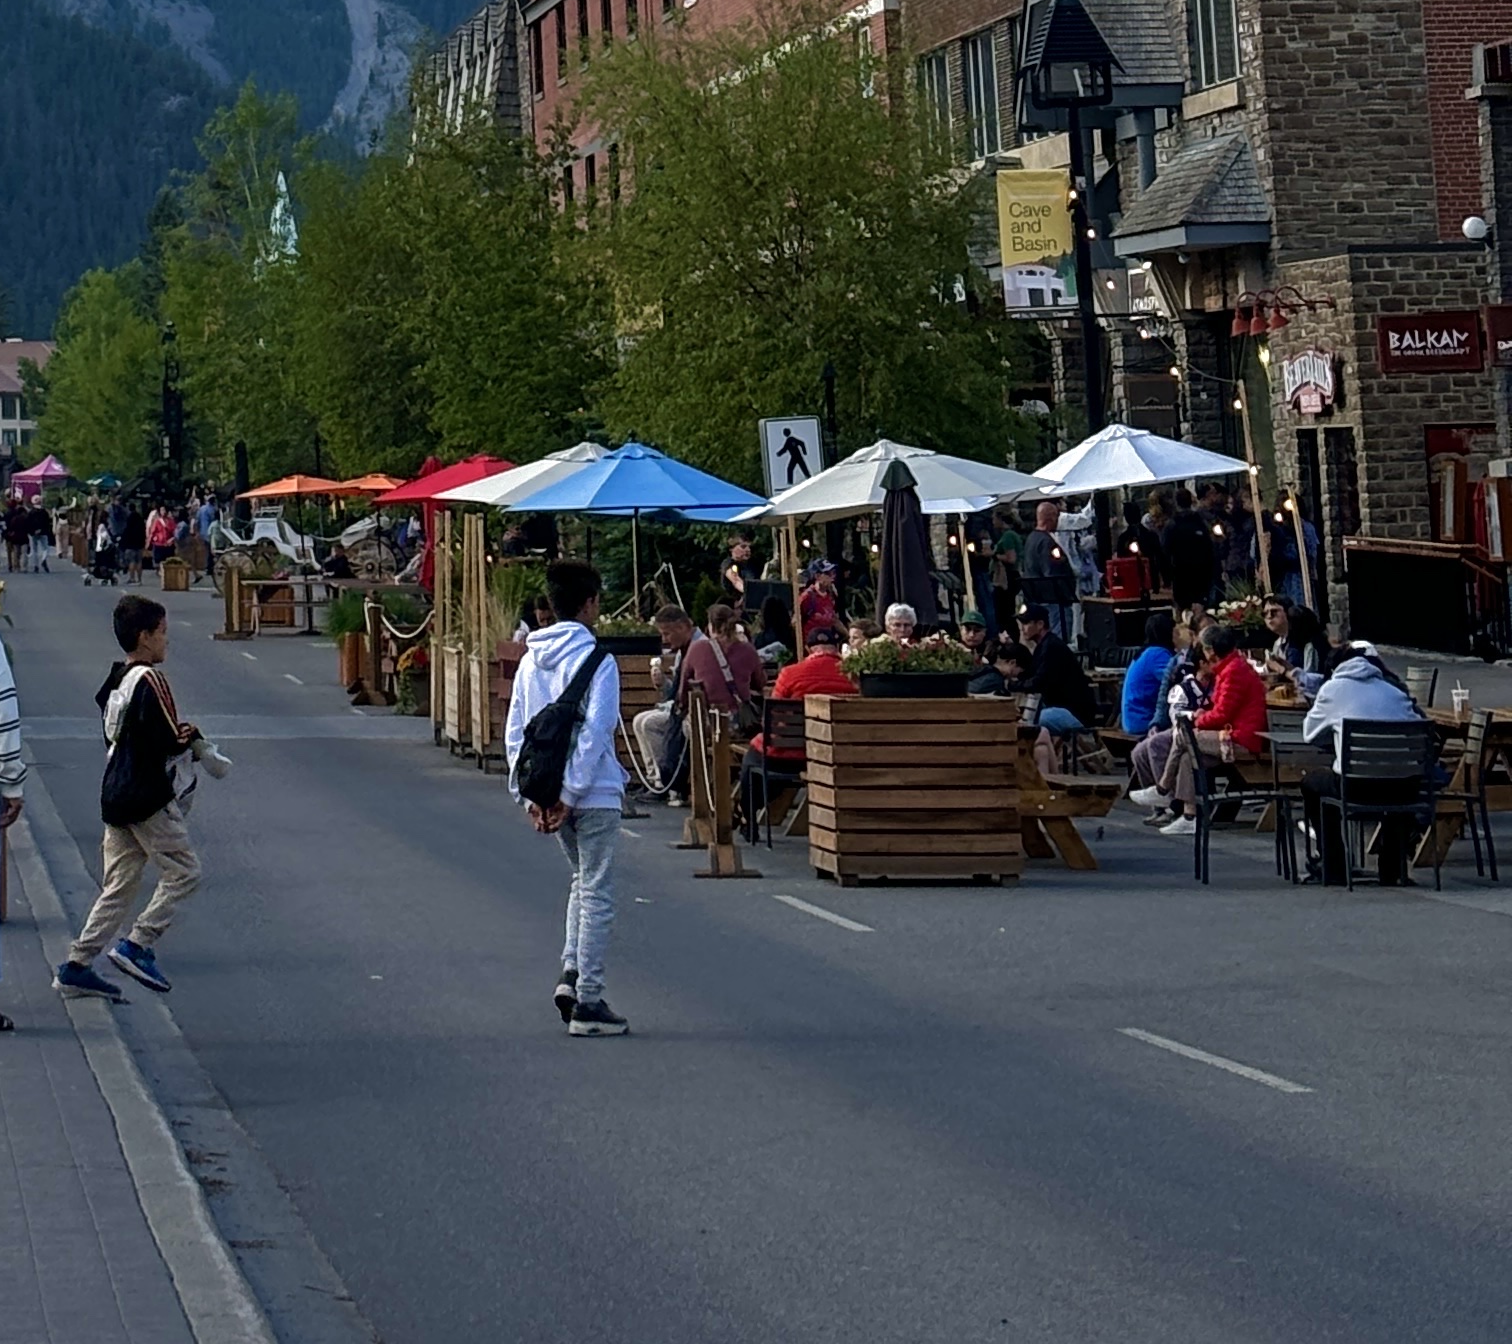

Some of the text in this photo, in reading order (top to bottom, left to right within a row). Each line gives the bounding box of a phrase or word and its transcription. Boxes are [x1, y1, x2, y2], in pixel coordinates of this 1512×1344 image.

[1009, 202, 1051, 218] Cave
[1010, 219, 1042, 234] and
[1012, 235, 1057, 251] Basin
[1388, 329, 1469, 349] BALKAN
